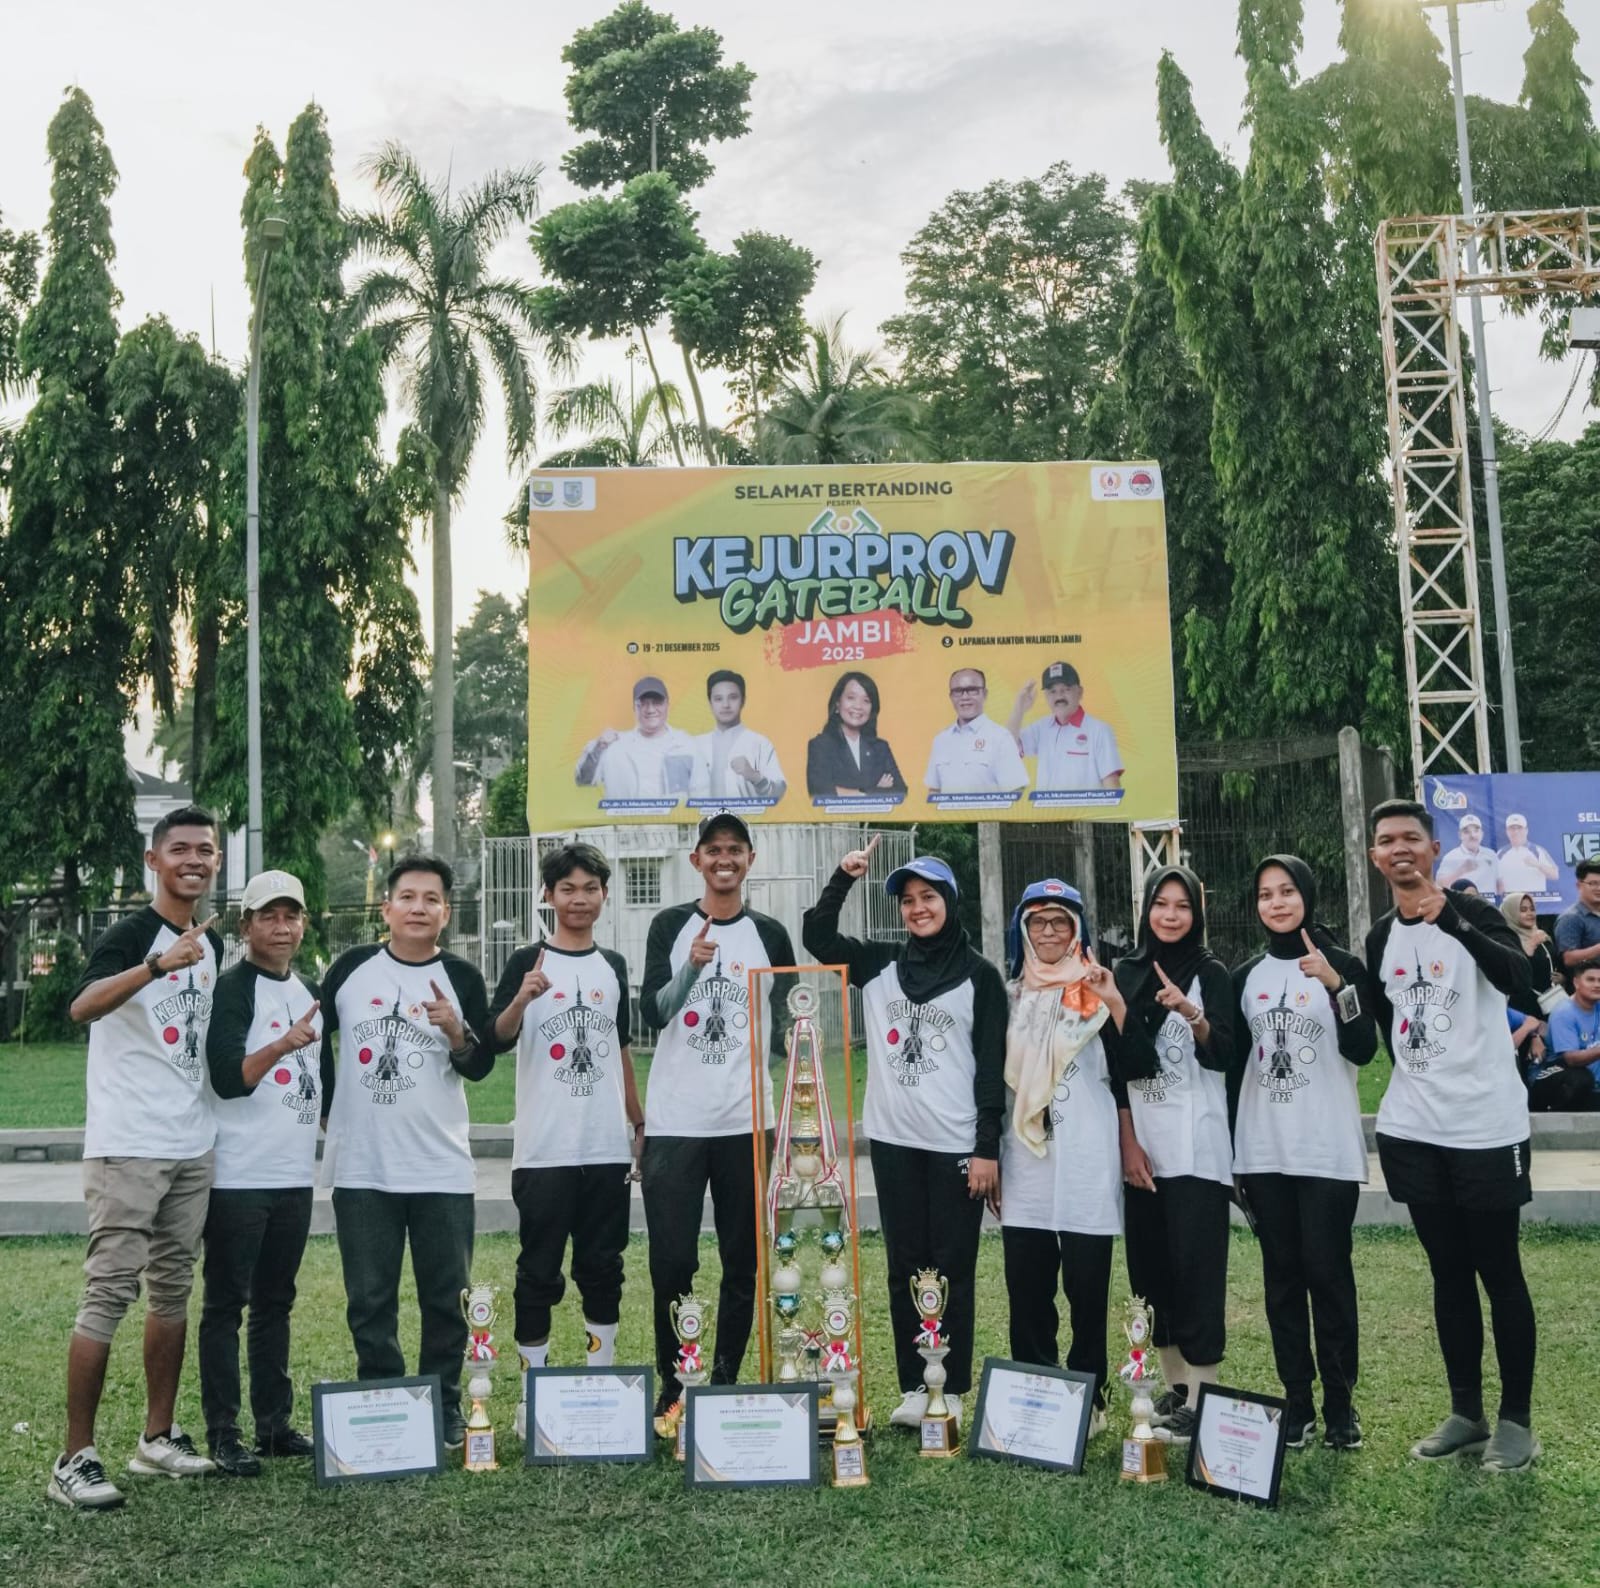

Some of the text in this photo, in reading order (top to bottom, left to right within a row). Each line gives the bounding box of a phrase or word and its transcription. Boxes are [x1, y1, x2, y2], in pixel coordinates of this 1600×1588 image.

[735, 480, 953, 500] SELAMAT BERTANDING
[673, 529, 1016, 604] KEJURPROV
[720, 573, 973, 634] GATEBALL
[796, 620, 890, 645] JAMBI
[958, 636, 996, 646] LAPANGAN
[664, 643, 701, 652] DESEMBER
[702, 642, 720, 652] 2025
[822, 646, 865, 661] 2025
[352, 1018, 435, 1050] KEJURPROV
[687, 1033, 743, 1054] GATEBALL
[360, 1071, 417, 1093] GATEBALL
[371, 1092, 397, 1105] 2025
